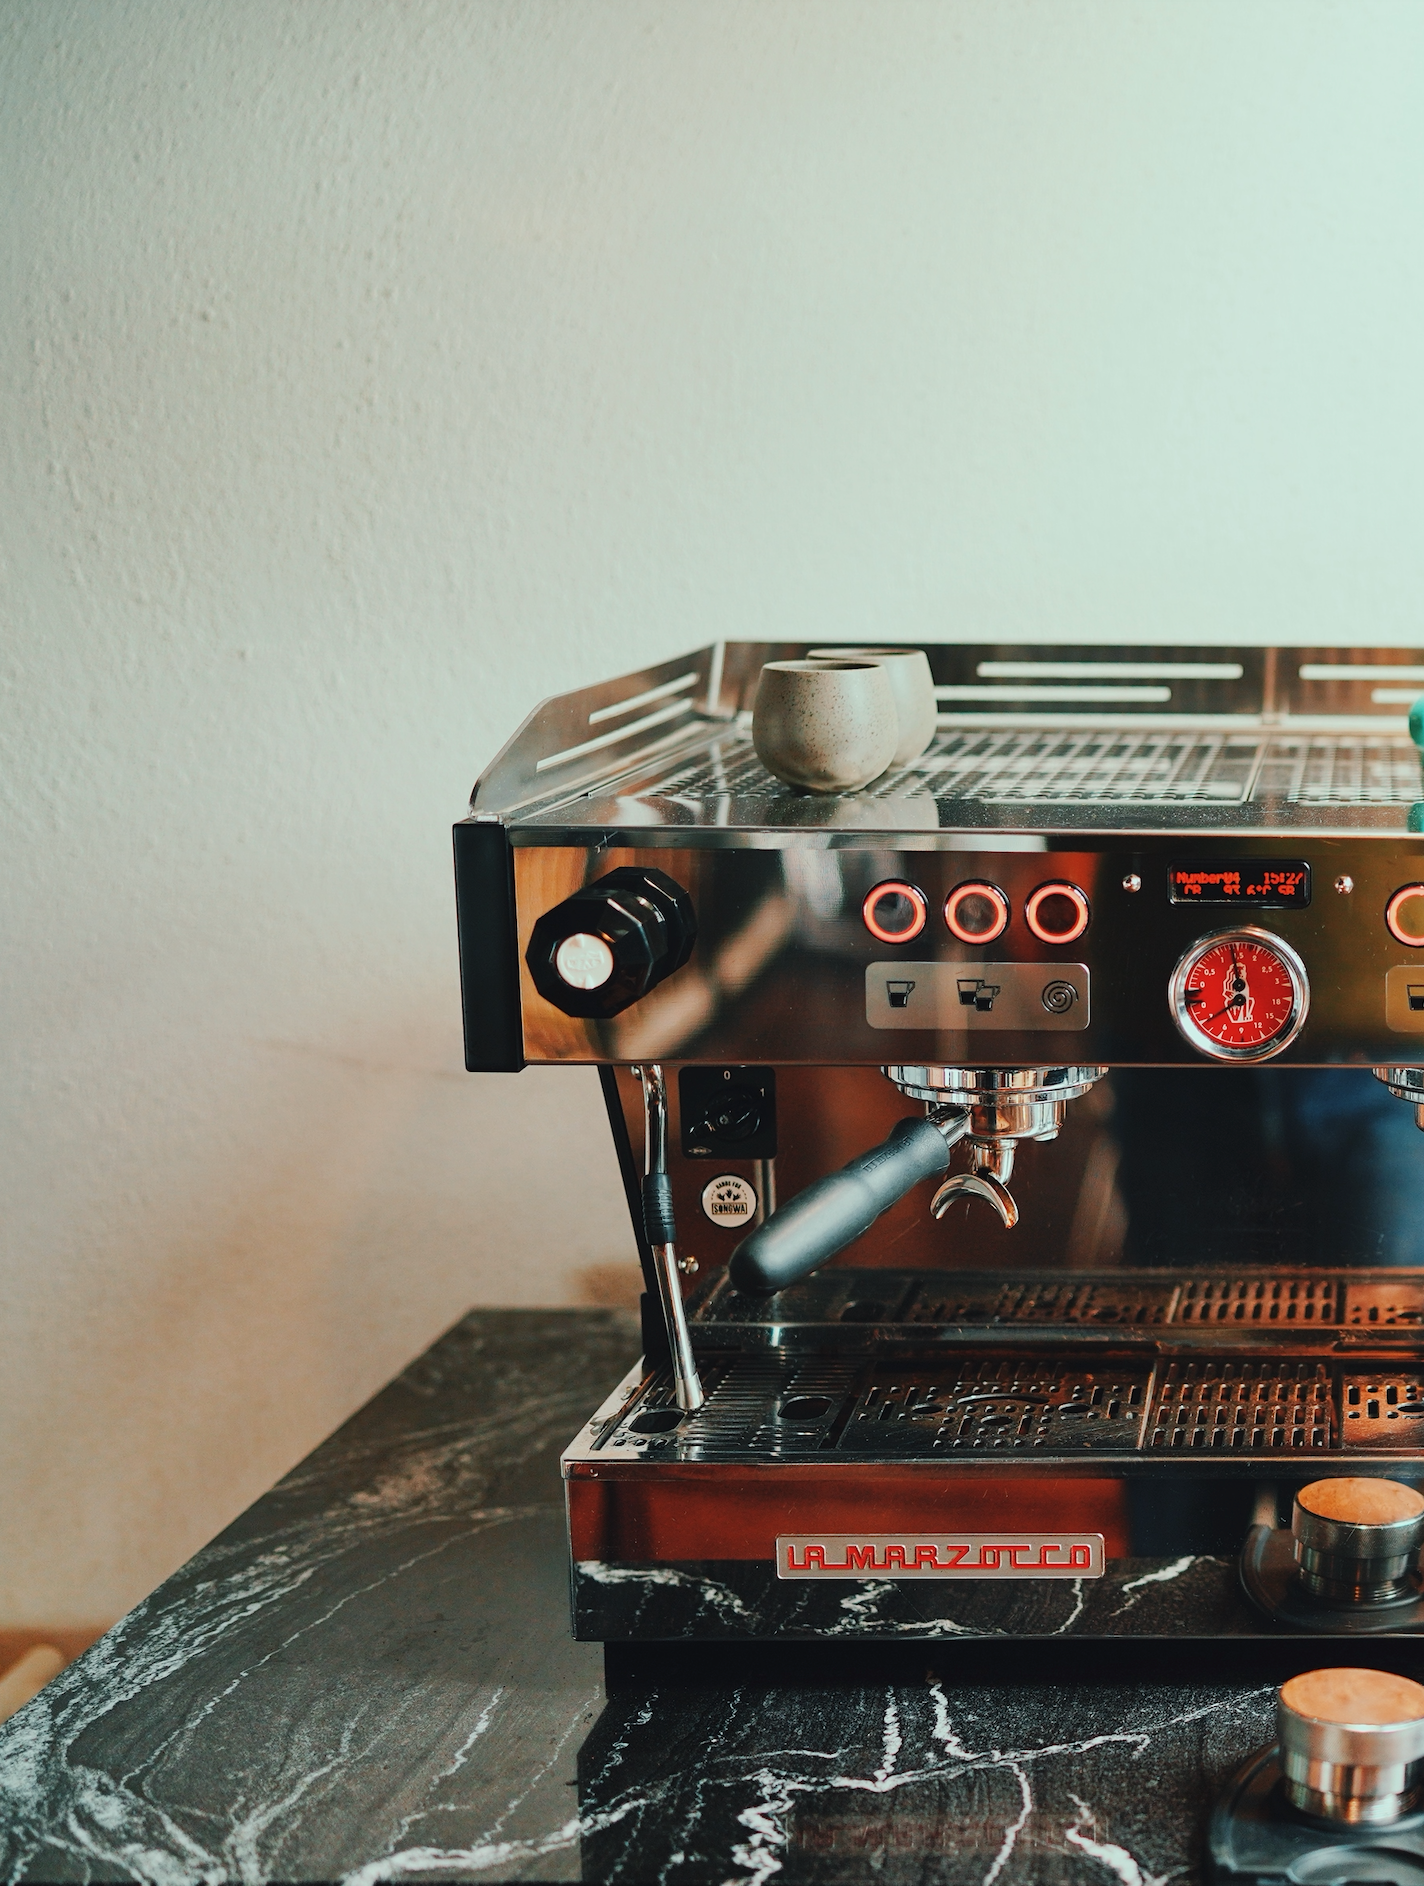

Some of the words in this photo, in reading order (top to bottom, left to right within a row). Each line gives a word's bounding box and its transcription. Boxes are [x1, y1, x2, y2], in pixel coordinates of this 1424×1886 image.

[1204, 968, 1216, 976] 0,5
[723, 1070, 731, 1080] 0
[760, 1088, 765, 1097] 1
[714, 1203, 745, 1214] SONGWA
[788, 1545, 824, 1570] LA
